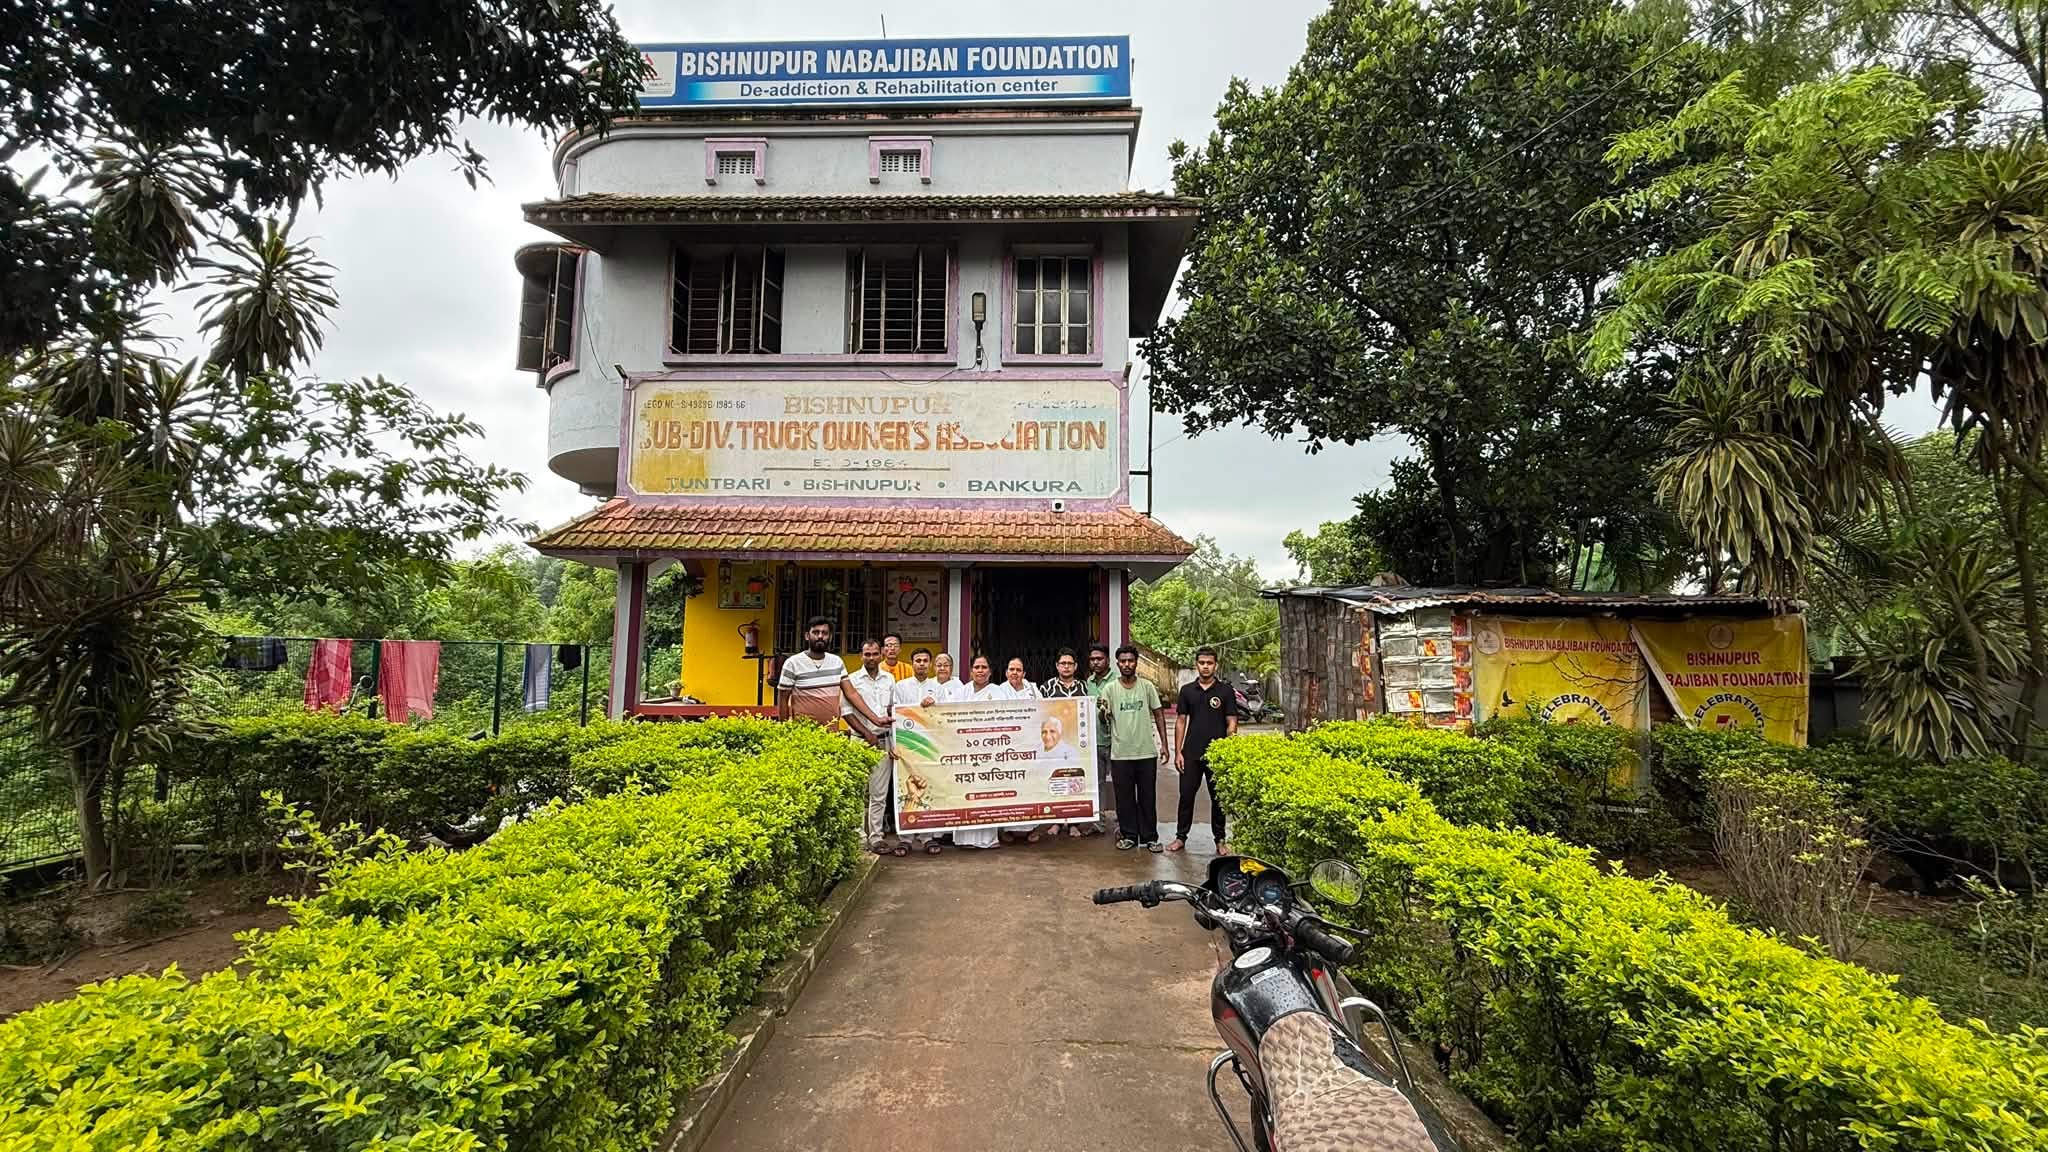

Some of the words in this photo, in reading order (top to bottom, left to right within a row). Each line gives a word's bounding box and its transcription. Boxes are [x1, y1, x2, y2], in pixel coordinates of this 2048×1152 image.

[681, 49, 817, 76] BISHNUPUR
[826, 47, 958, 74] NABAJIBAN
[967, 45, 1119, 71] FOUNDATION
[740, 82, 850, 97] De-addiction
[856, 81, 868, 95] &
[875, 79, 996, 95] Rehabilitation
[1002, 79, 1058, 92] center
[667, 477, 771, 490] TUNTBARI
[968, 479, 1082, 492] BANKURA
[1504, 637, 1544, 650] BISHNUPUR
[1546, 639, 1589, 651] NABAJIBAN
[1687, 651, 1761, 666] BISHNUPUR
[1722, 671, 1804, 687] FOUNDATION
[1541, 694, 1612, 725] ELEBRATIN
[966, 739, 980, 748] ১০
[982, 734, 1011, 747] কোটি
[940, 753, 967, 766] নেশা
[969, 751, 992, 767] মুক্ত
[994, 748, 1037, 763] প্রতিজ্ঞা
[954, 771, 975, 783] মহা
[978, 767, 1026, 782] অভিযান
